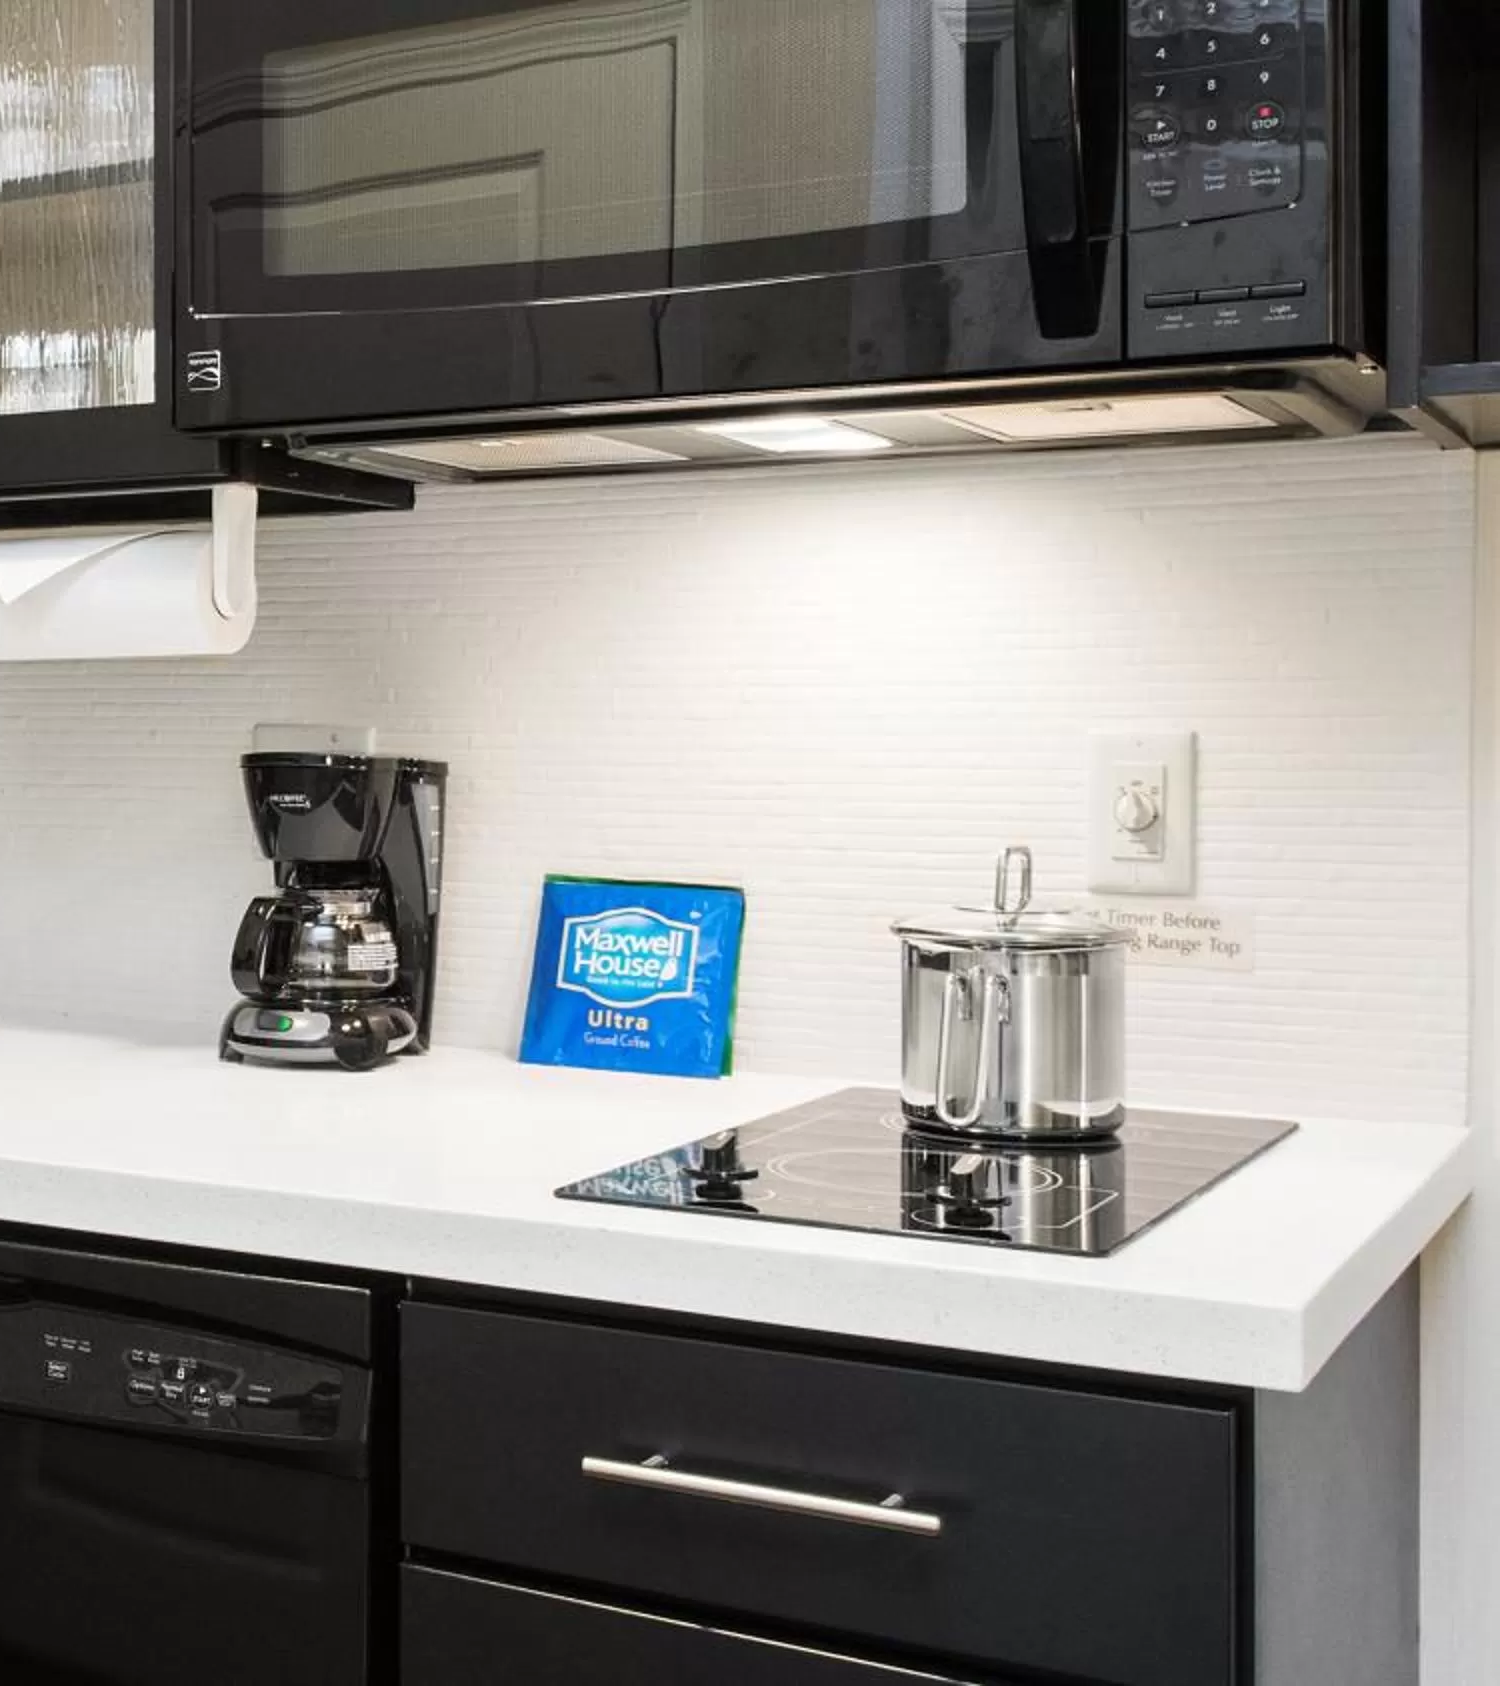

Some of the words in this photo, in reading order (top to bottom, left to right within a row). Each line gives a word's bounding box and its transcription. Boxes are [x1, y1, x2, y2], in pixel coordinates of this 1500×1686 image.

[1206, 2, 1216, 15] 2
[1260, 33, 1270, 45] 6
[1206, 40, 1216, 52] 5
[1155, 48, 1166, 59] 4
[1260, 72, 1269, 84] 9
[1155, 85, 1165, 97] 7
[1207, 79, 1216, 91] 8
[1206, 119, 1217, 131] 0
[1252, 118, 1279, 131] STOP
[1147, 131, 1175, 143] START
[1108, 908, 1158, 926] Timer
[1163, 911, 1221, 931] Before
[574, 926, 685, 957] Maxwell
[1147, 933, 1202, 956] Range
[1209, 936, 1241, 959] Top
[574, 951, 660, 979] House
[588, 1009, 649, 1031] Ultra
